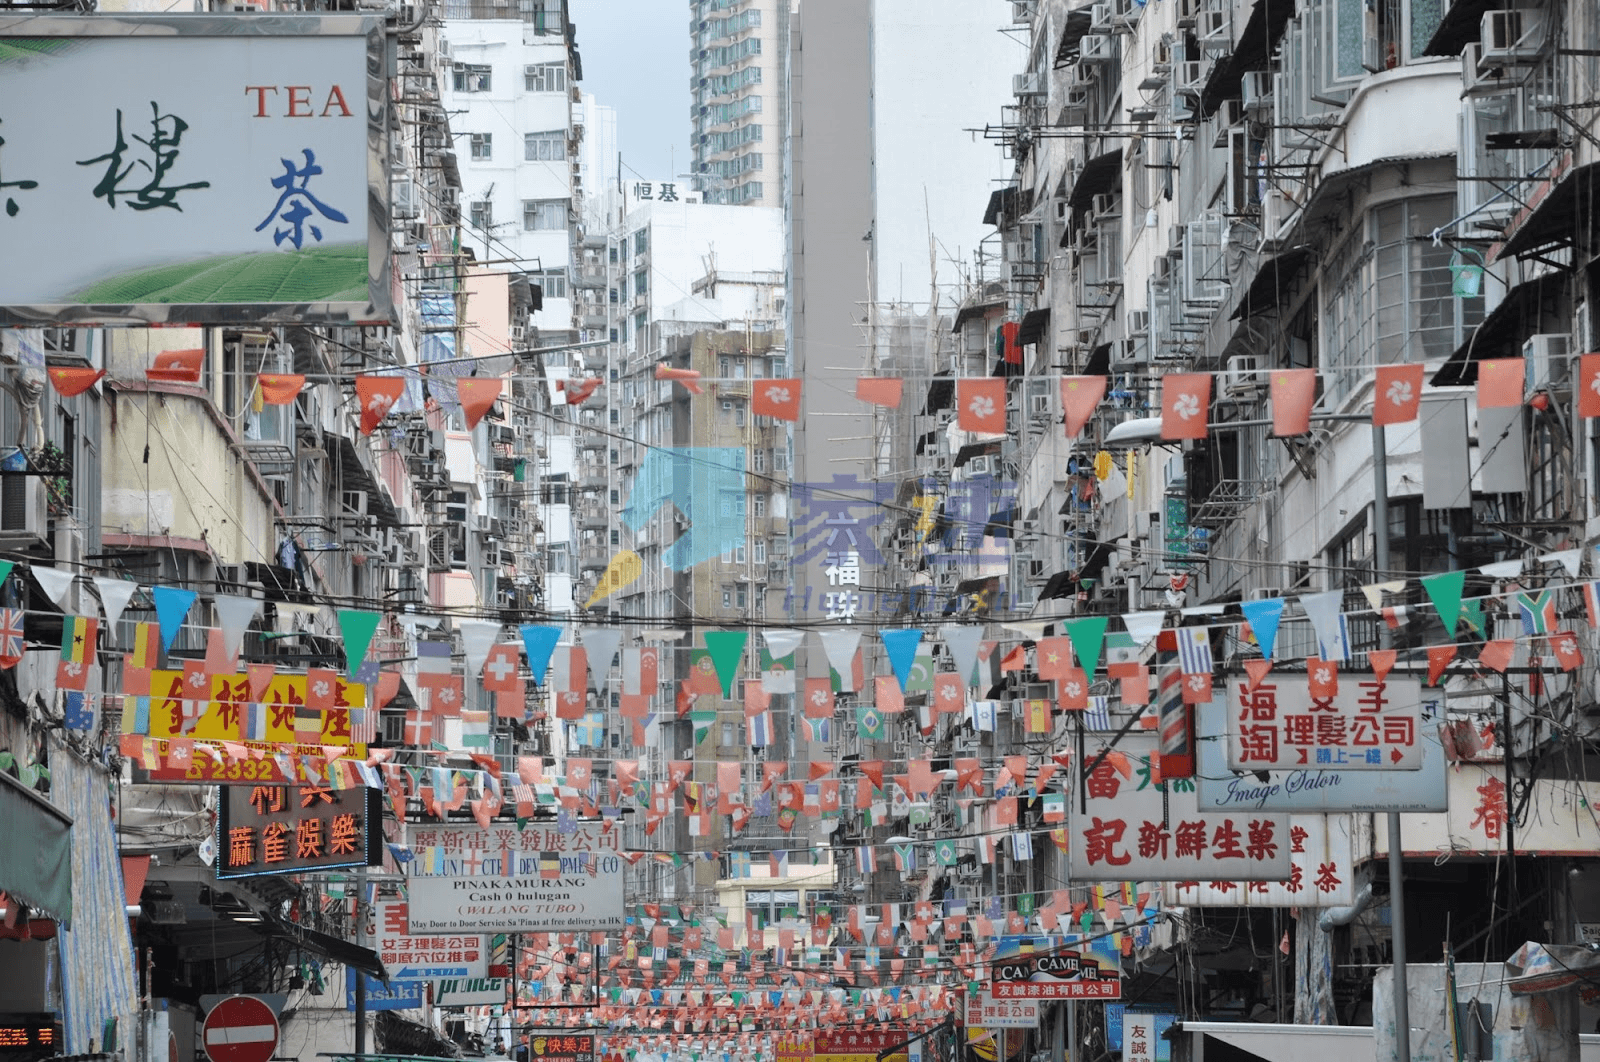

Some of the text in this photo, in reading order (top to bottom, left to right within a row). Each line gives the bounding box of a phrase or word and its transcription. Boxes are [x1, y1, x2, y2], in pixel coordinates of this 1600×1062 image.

[245, 85, 354, 117] TEA
[255, 148, 349, 249] 茶
[1284, 715, 1414, 747] 理髮公司
[211, 760, 273, 780] 2332
[1215, 770, 1342, 810] Image Salon
[453, 878, 586, 889] PINAKAMURANG
[469, 892, 501, 902] Cash
[517, 891, 570, 902] hulugan
[411, 920, 427, 929] May
[430, 920, 447, 928] Door
[459, 920, 476, 928] Door
[478, 919, 506, 927] Service
[507, 919, 517, 927] Sa
[551, 918, 565, 926] free
[567, 917, 596, 928] delivery
[608, 917, 621, 925] HK
[382, 937, 479, 950] 女子理髮公司
[1037, 957, 1079, 971] CAMEL
[984, 1006, 1035, 1017] 理髮公司
